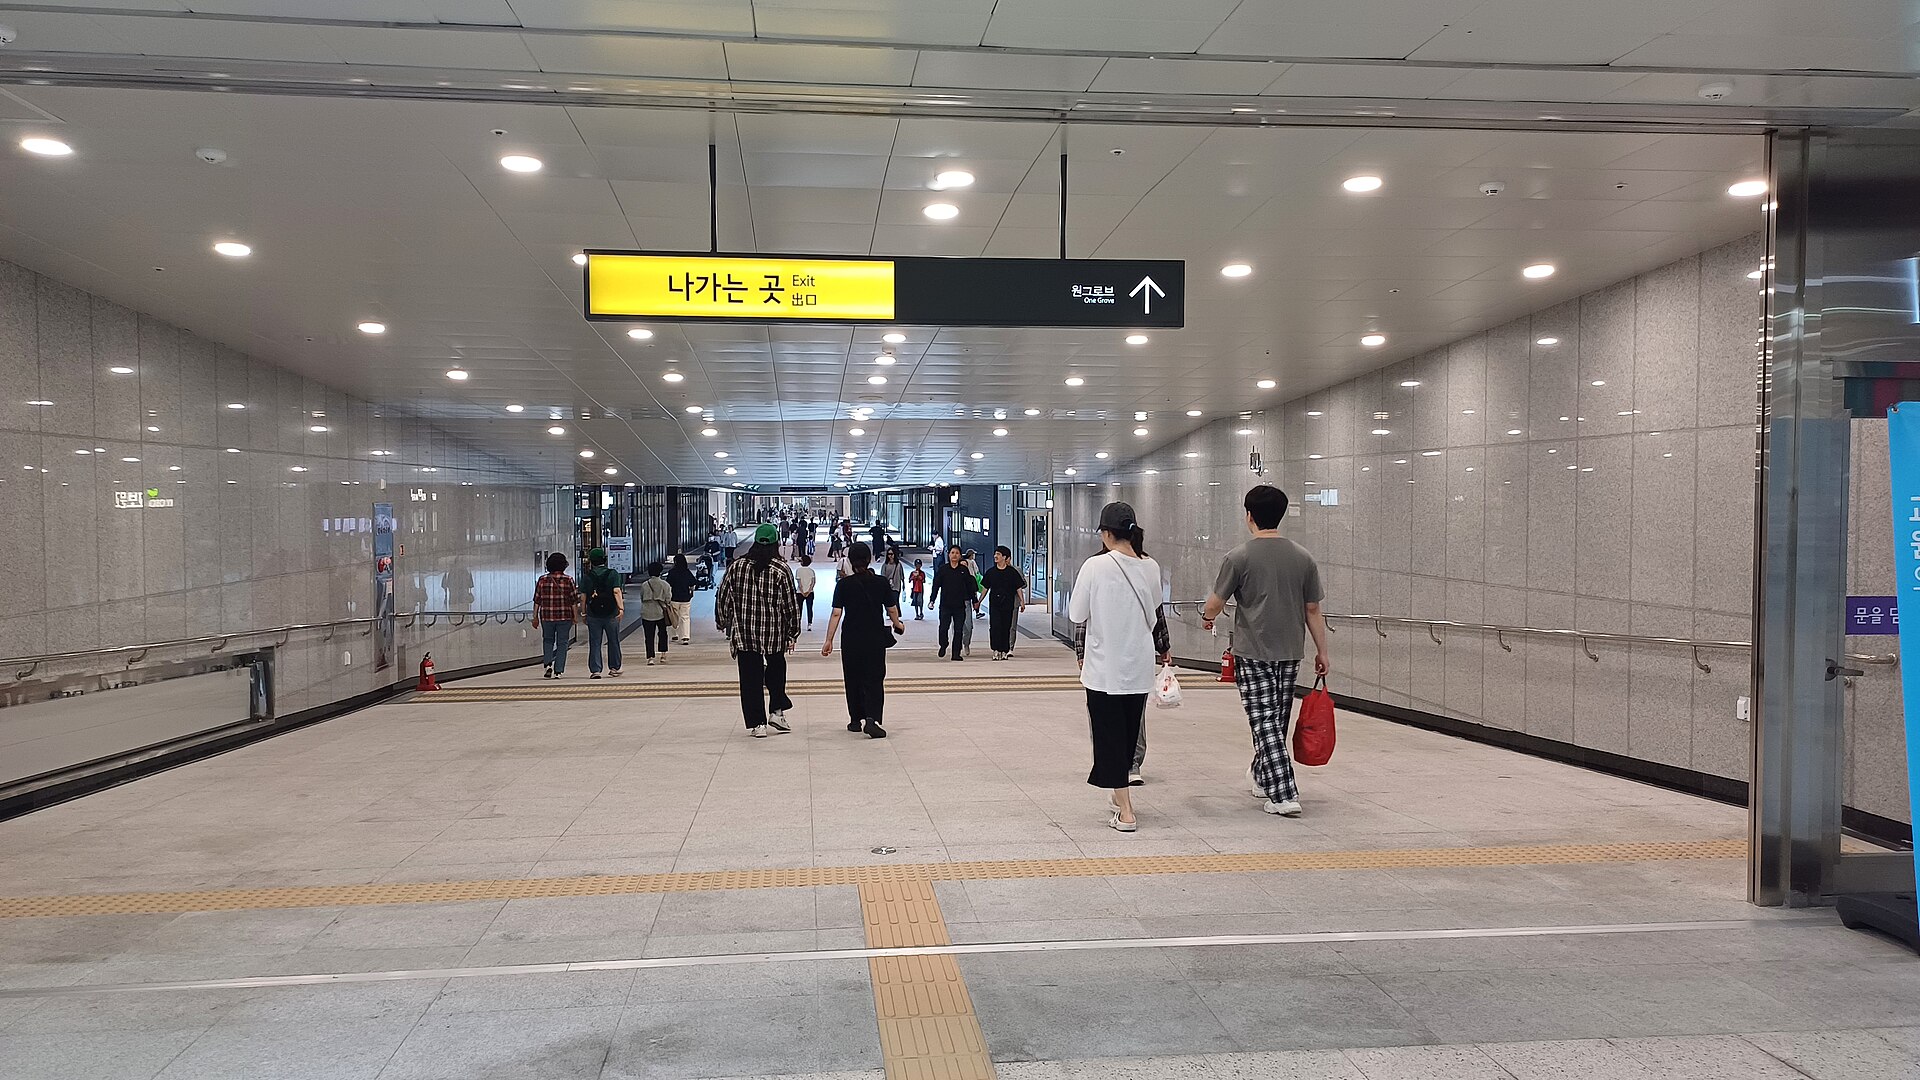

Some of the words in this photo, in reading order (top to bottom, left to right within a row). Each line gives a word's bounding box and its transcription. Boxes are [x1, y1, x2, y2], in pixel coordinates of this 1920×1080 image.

[669, 272, 748, 303] 나가는
[759, 275, 785, 304] 곳
[792, 275, 815, 287] Exit
[1071, 284, 1115, 298] 원그로브
[792, 292, 817, 306] 出口
[1854, 607, 1884, 624] 문을
